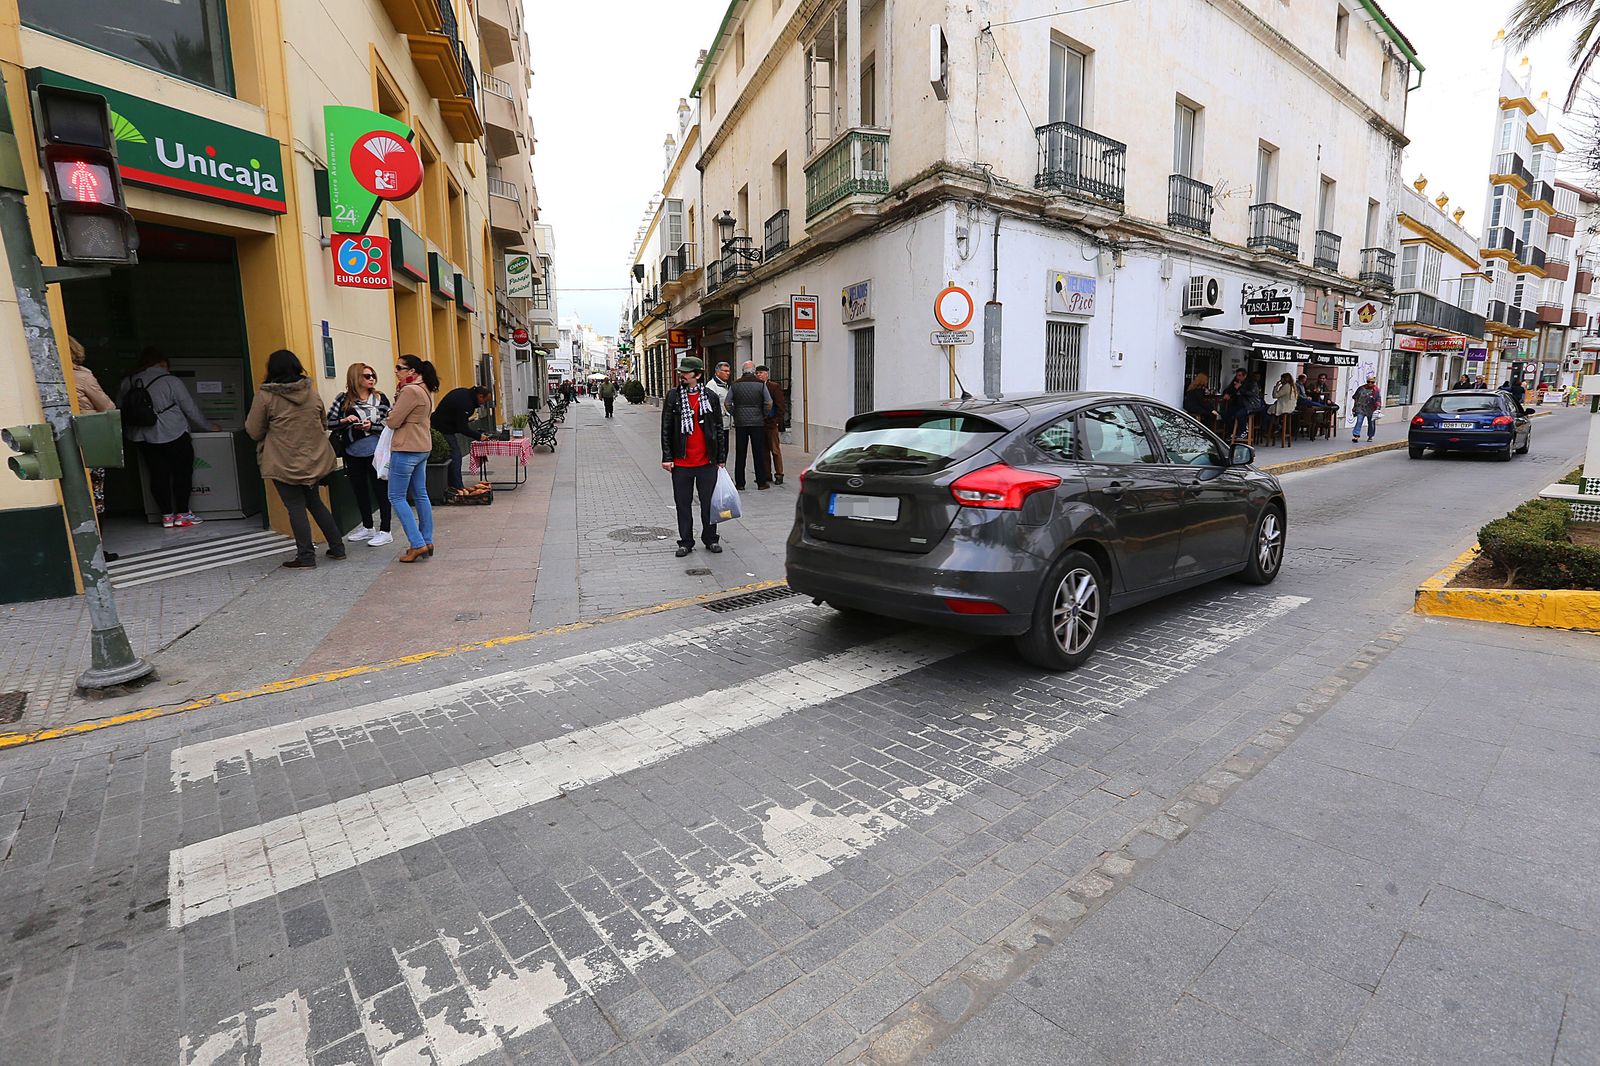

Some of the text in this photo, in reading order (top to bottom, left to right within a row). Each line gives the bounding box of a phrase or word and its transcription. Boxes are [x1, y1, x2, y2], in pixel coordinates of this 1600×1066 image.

[155, 137, 278, 195] Unicaja
[337, 275, 387, 285] EURO 6000
[1246, 301, 1291, 313] TASCA EL 22
[1261, 349, 1279, 360] TASCA
[1285, 351, 1292, 360] 22
